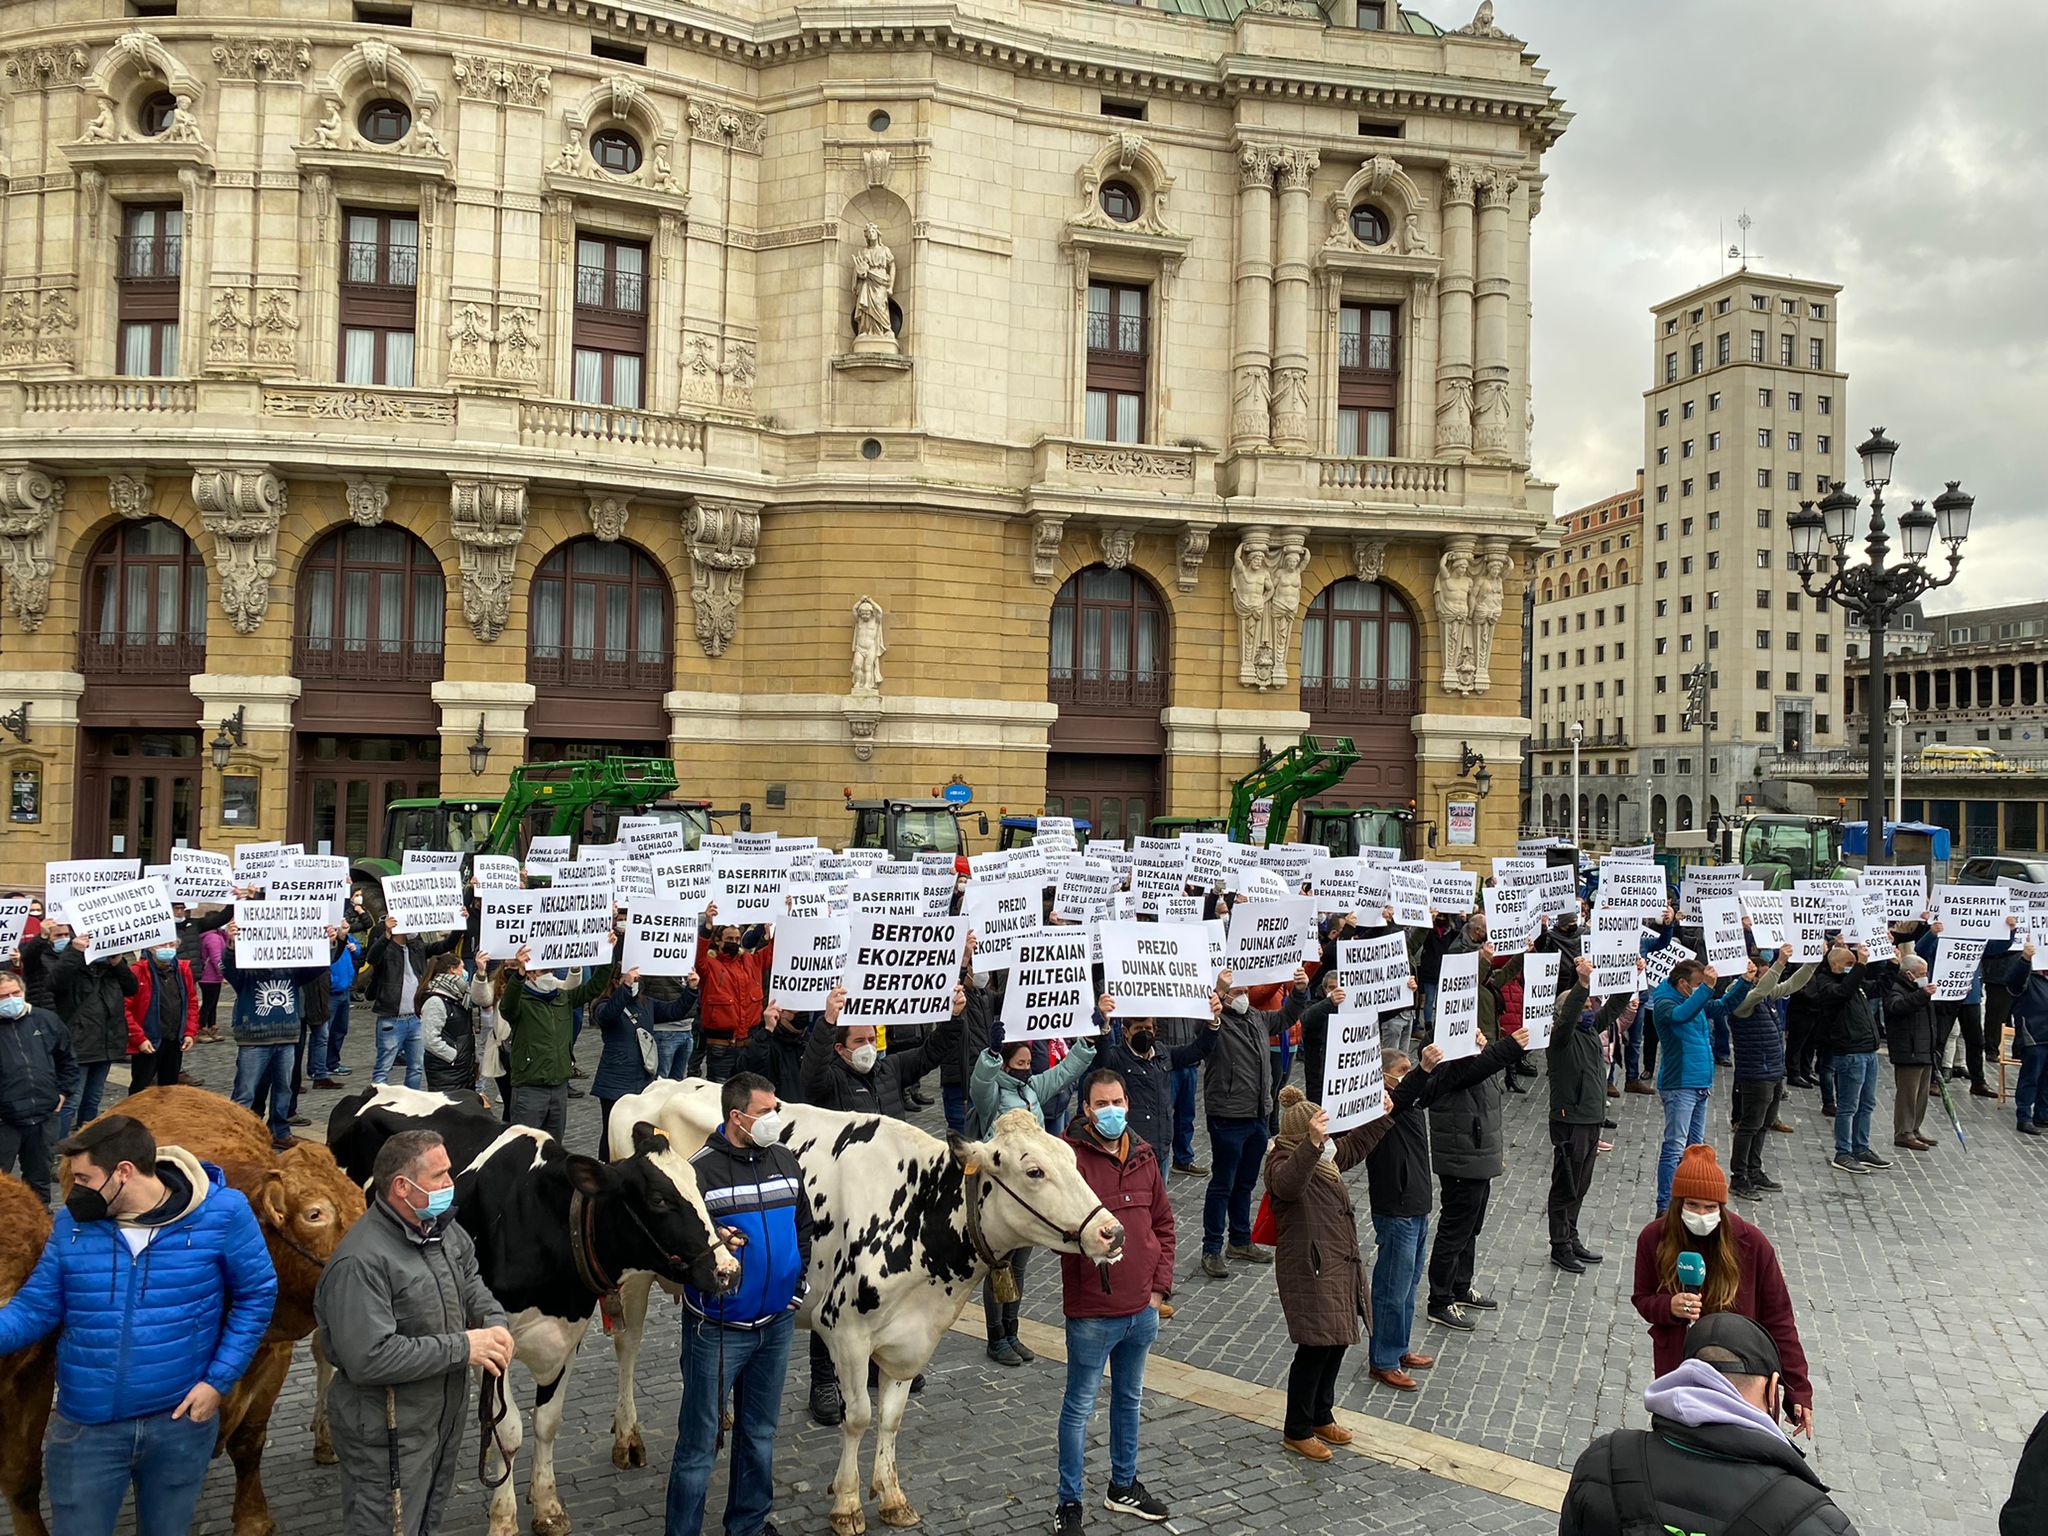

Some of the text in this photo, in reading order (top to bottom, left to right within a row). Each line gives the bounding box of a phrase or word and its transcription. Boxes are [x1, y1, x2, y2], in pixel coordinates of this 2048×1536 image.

[630, 831, 678, 842] BASERRITAR
[638, 841, 672, 851] GEHIAGO
[1140, 841, 1181, 850] BASOGINTZA
[173, 853, 230, 868] DISTRIBUZIO
[246, 860, 275, 870] GEHIAGO
[410, 854, 457, 863] BASOGINTZA
[1134, 860, 1184, 868] LURRALDEAREN
[1260, 858, 1286, 866] BERTOKO
[50, 872, 91, 884] BERTOKO
[94, 870, 136, 880] EKOIZPENA
[186, 866, 223, 876] KATEEK
[235, 872, 260, 880] BEHAR
[558, 866, 596, 880] NEKAZARITZA
[718, 870, 787, 878] BASERRITIK
[1066, 872, 1109, 884] CUMPLIMIENTO
[1138, 870, 1182, 880] BIZKAIAN
[1513, 873, 1552, 886] NEKAZARITZA
[1554, 870, 1568, 880] BADU
[174, 877, 232, 887] KATEATZEN
[272, 880, 343, 890] BASERRITIK
[391, 877, 456, 893] NEKAZARITZA BADU
[667, 878, 690, 888] BIZI
[1138, 882, 1180, 891] HILTEGIA
[1260, 877, 1278, 886] BASO
[1614, 875, 1662, 884] BASERRITAR
[176, 889, 228, 898] GAITUZTE
[680, 890, 706, 900] DUGU
[726, 884, 780, 894] BIZI NAHI
[1064, 884, 1092, 894] EFECTIVO
[1094, 886, 1100, 894] DE
[1430, 888, 1464, 896] FORESTAL
[1549, 884, 1574, 897] ARDURAZ
[1621, 887, 1656, 896] GEHIAGO
[78, 885, 156, 912] CUMPLIMIENTO
[540, 894, 607, 914] NEKAZARITZA BADU
[737, 899, 770, 908] DUGU
[853, 892, 920, 902] BASERRITIK
[1058, 894, 1069, 902] LEY
[1608, 898, 1667, 907] BEHAR DOGUZ
[1944, 896, 2006, 905] BASERRITIK
[82, 898, 162, 926] EFECTIVO DE LA
[890, 906, 914, 915] NAHI
[998, 897, 1026, 913] PREZIO
[244, 906, 321, 921] NEKAZARITZA BADU
[406, 912, 454, 926] JOKA DEZAGUN
[632, 914, 697, 927] BASERRITIK
[104, 911, 171, 936] DE LA CADENA
[496, 920, 524, 929] BIZI
[530, 920, 580, 938] ETORKIZUNA,
[985, 914, 1036, 934] DUINAK GURE
[1257, 917, 1288, 932] PREZIO
[1599, 918, 1638, 931] BASOGINTZA
[94, 928, 161, 951] ALIMENTARIA
[292, 926, 328, 940] ARDURAZ
[640, 931, 694, 943] BIZI NAHI
[872, 924, 955, 942] BERTOKO
[814, 934, 841, 950] PREZIO
[1138, 940, 1178, 954] PREZIO
[1240, 934, 1298, 950] DUINAK GURE
[253, 946, 313, 961] JOKA DEZAGUN
[541, 941, 599, 961] JOKA DEZAGUN
[653, 947, 688, 959] DUGU
[858, 948, 956, 966] EKOIZPENA
[1020, 944, 1086, 962] BIZKAIAN
[1346, 944, 1390, 964] NEKAZARITZA
[791, 955, 833, 970] DUINAK
[1227, 950, 1302, 970] EKOIZPENETARAKO
[1122, 960, 1198, 977] DUINAK GURE
[862, 974, 947, 990] BERTOKO
[1019, 966, 1086, 986] HILTEGIA
[1340, 966, 1385, 987] ETORKIZUNA,
[1598, 972, 1630, 987] KUDEAKETA
[1108, 981, 1212, 998] EKOIZPENETARAKO
[1026, 990, 1080, 1008] BEHAR
[1354, 986, 1401, 1008] JOKA DEZAGUN
[844, 996, 950, 1015] MERKATURA
[1445, 999, 1460, 1015] BIZI
[1026, 1013, 1073, 1030] DOGU
[1450, 1020, 1470, 1037] DUGU
[1328, 1073, 1370, 1096] LEY DE LA
[1337, 1090, 1382, 1119] ALIMENTARIA
